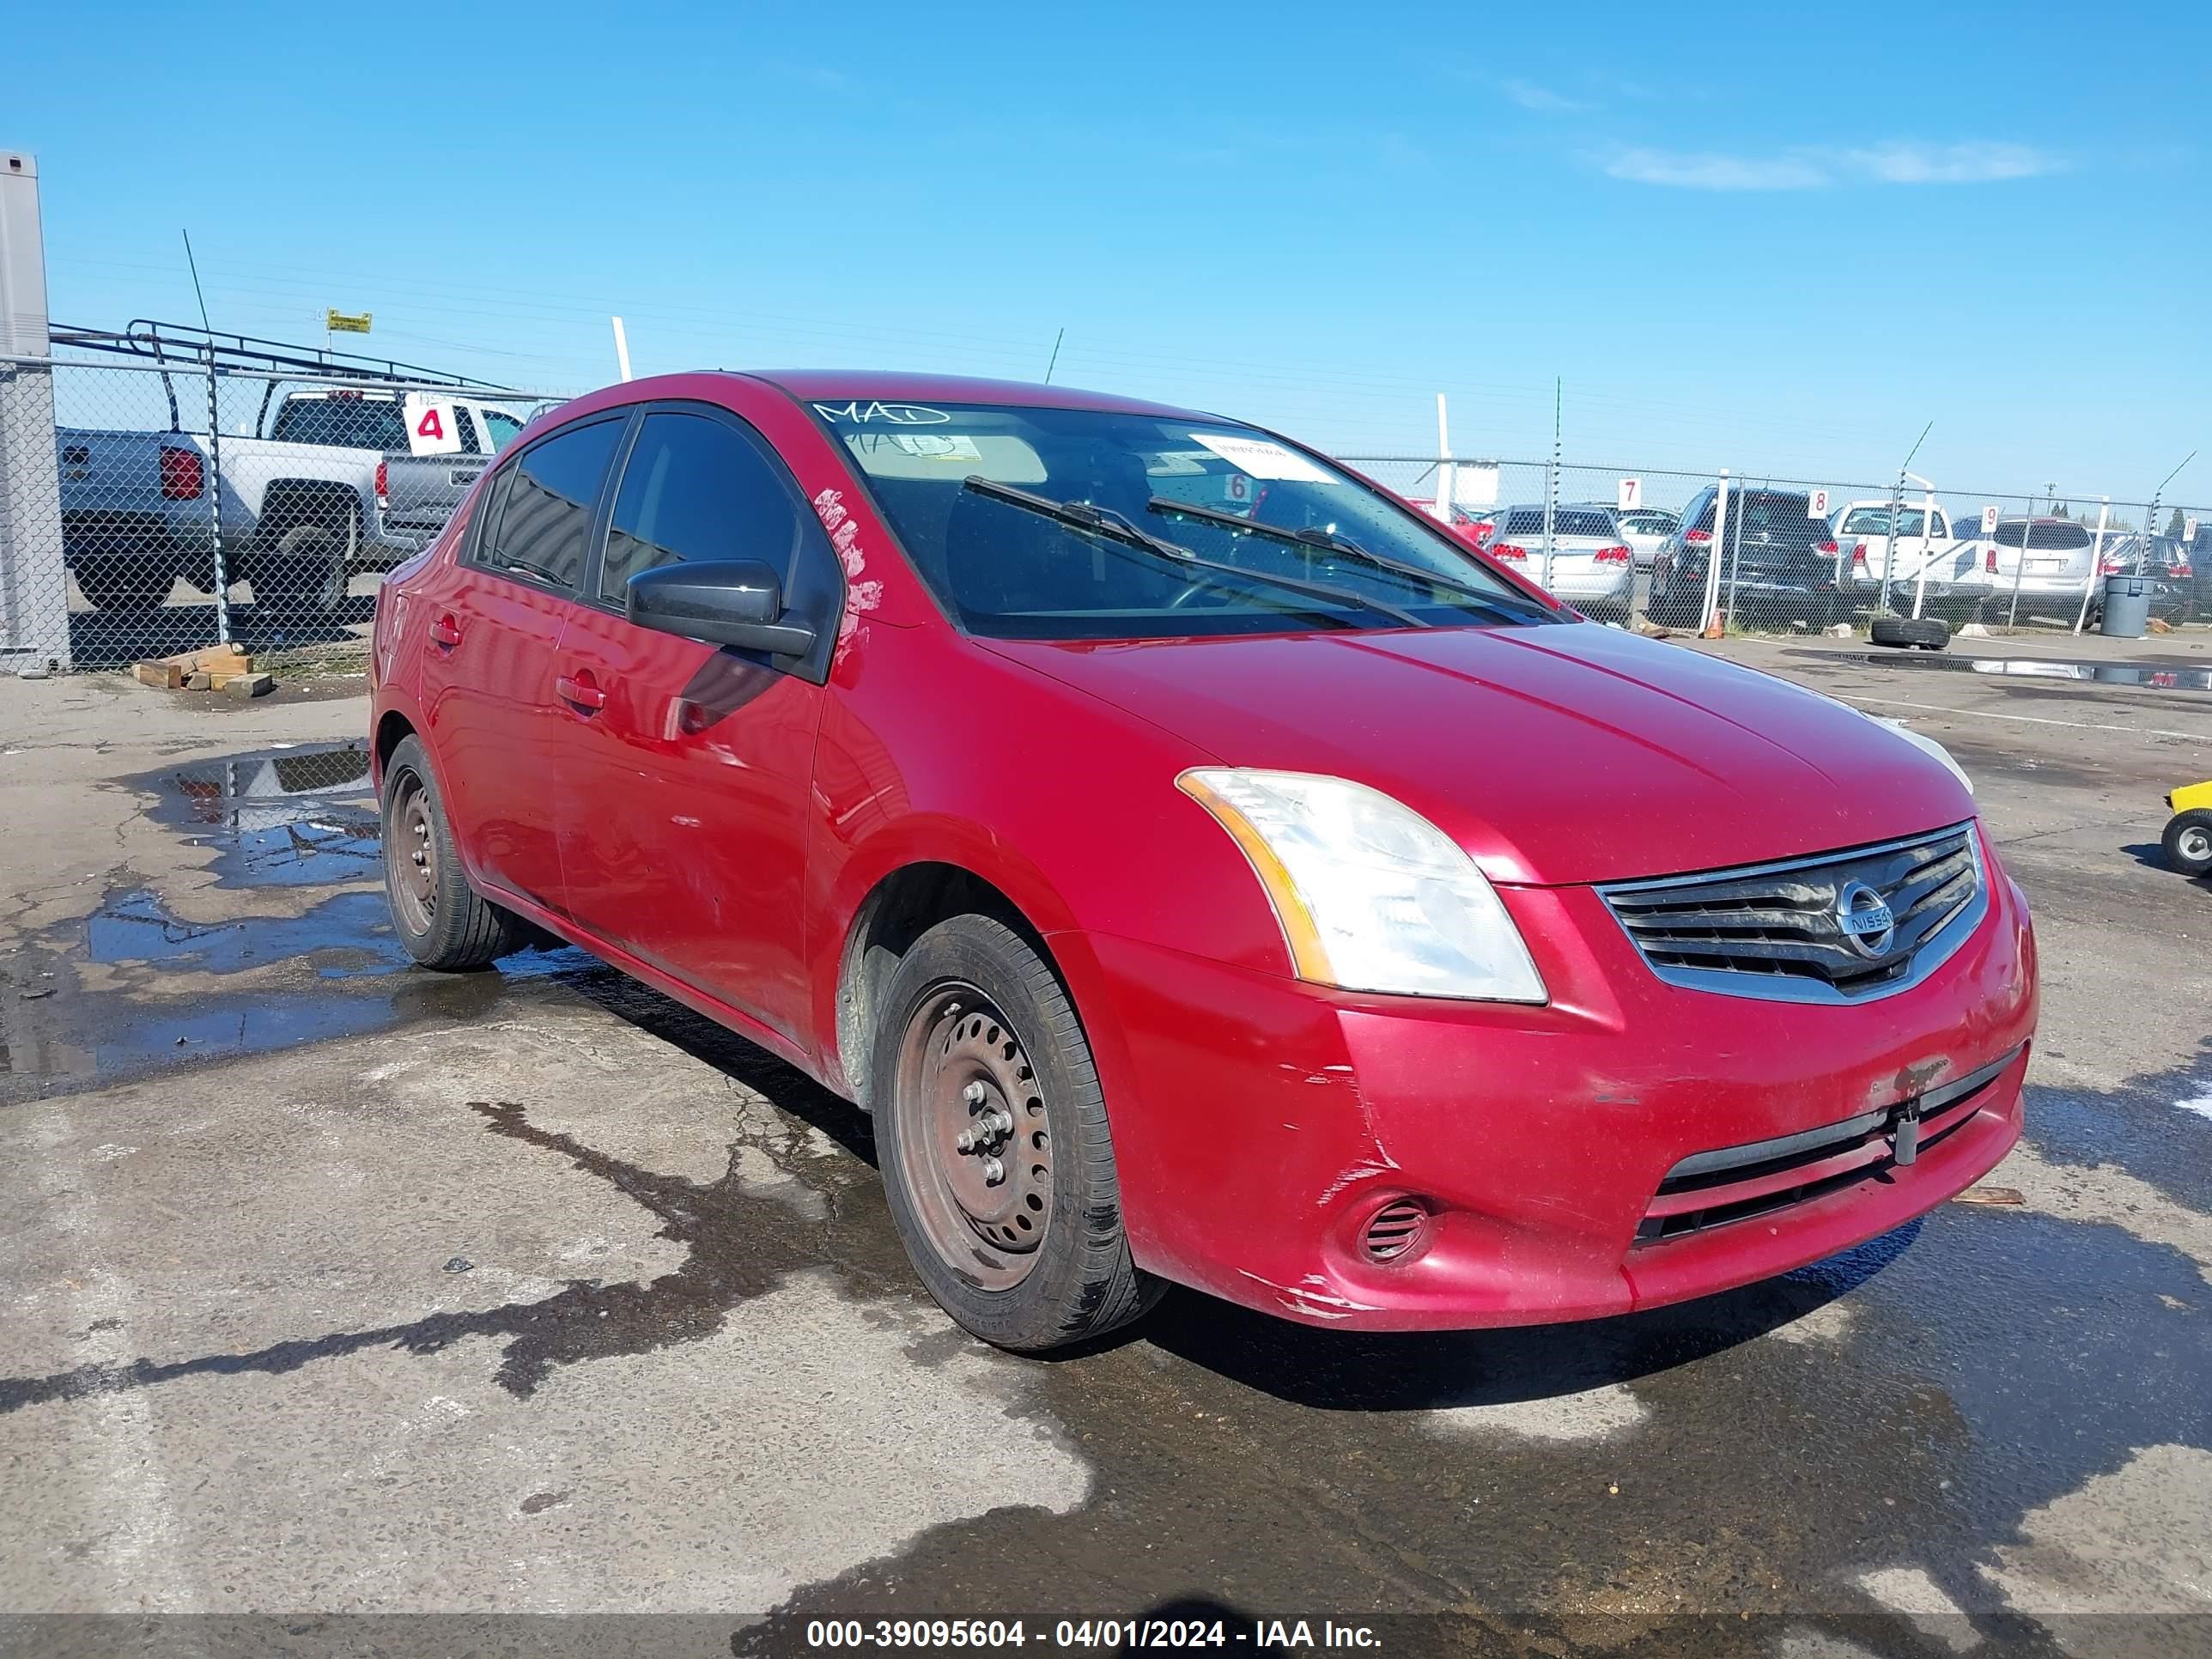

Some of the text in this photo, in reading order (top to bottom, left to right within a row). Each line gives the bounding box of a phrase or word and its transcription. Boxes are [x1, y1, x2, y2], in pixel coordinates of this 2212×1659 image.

[417, 407, 443, 441] 4
[812, 401, 951, 425] MAD
[1231, 474, 1246, 499] 6
[1625, 481, 1637, 502] 7
[1815, 492, 1826, 511] 8
[1987, 507, 1996, 526] 9
[2185, 519, 2196, 536] 10
[1851, 908, 1893, 931] NISSAN
